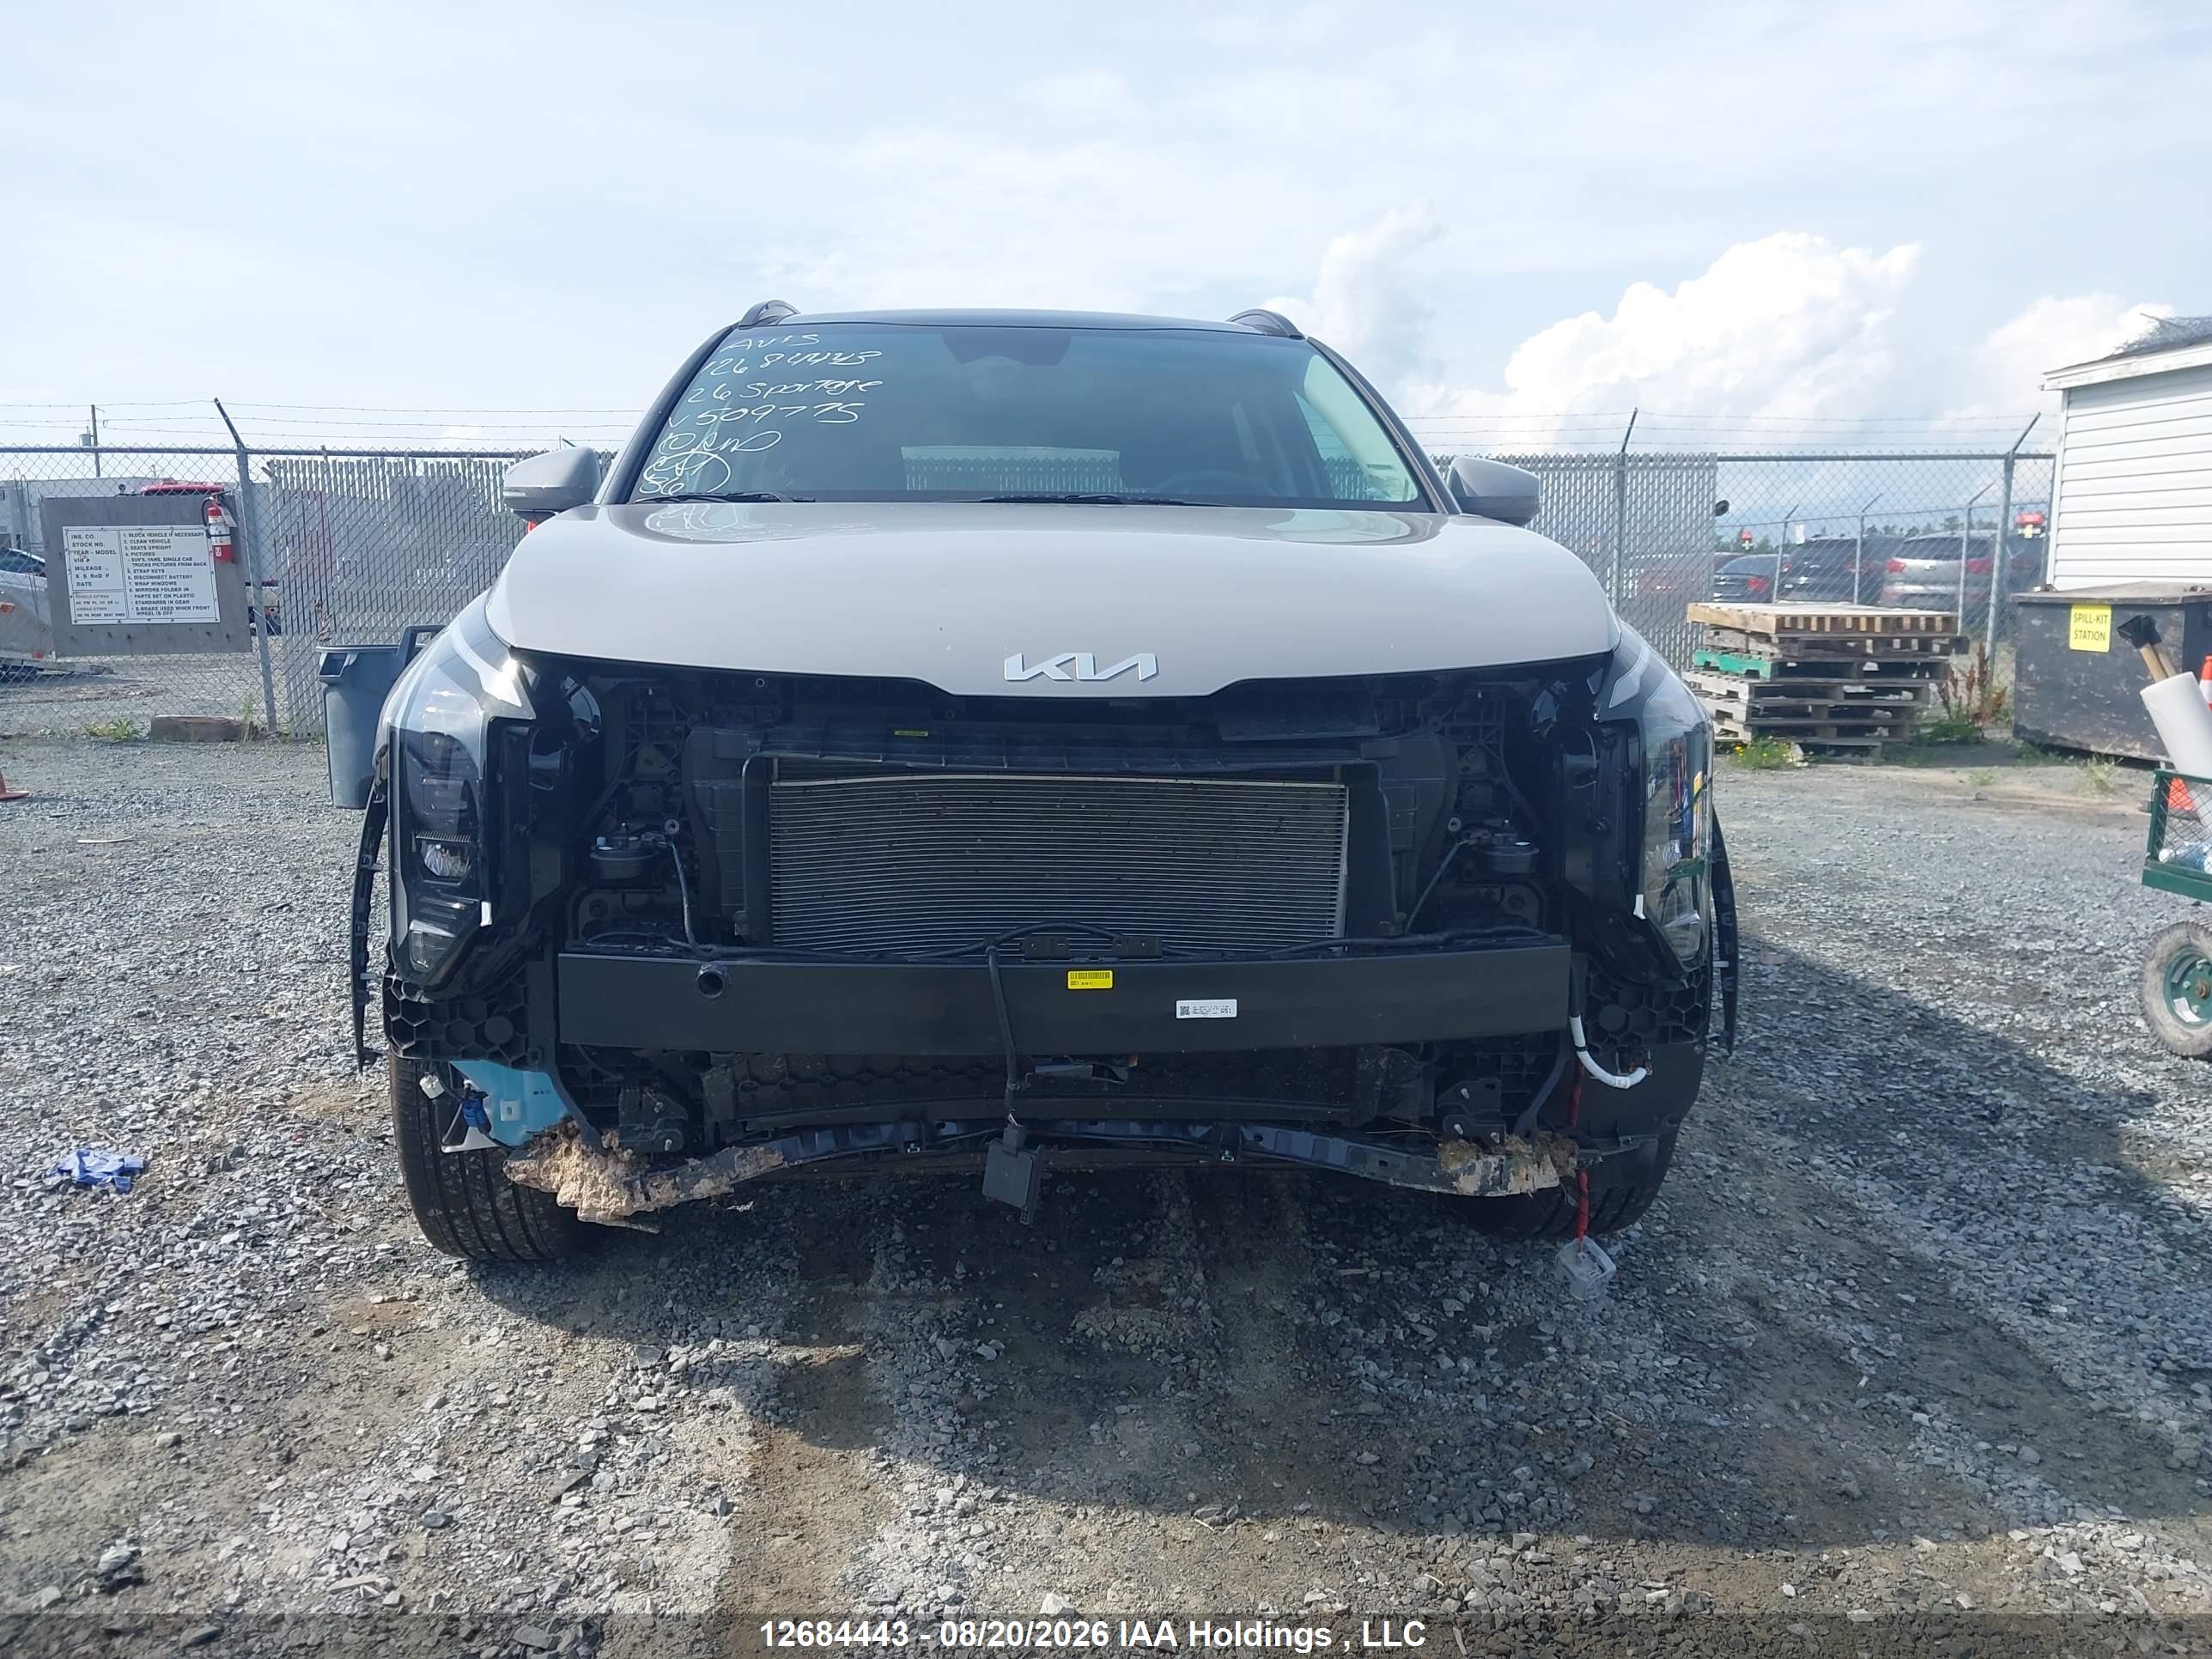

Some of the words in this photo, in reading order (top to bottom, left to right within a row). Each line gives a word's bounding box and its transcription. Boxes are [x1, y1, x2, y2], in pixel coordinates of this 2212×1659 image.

[2074, 612, 2109, 625] SPILL-KIT
[2074, 629, 2106, 641] STATION
[1004, 653, 1158, 681] KIA
